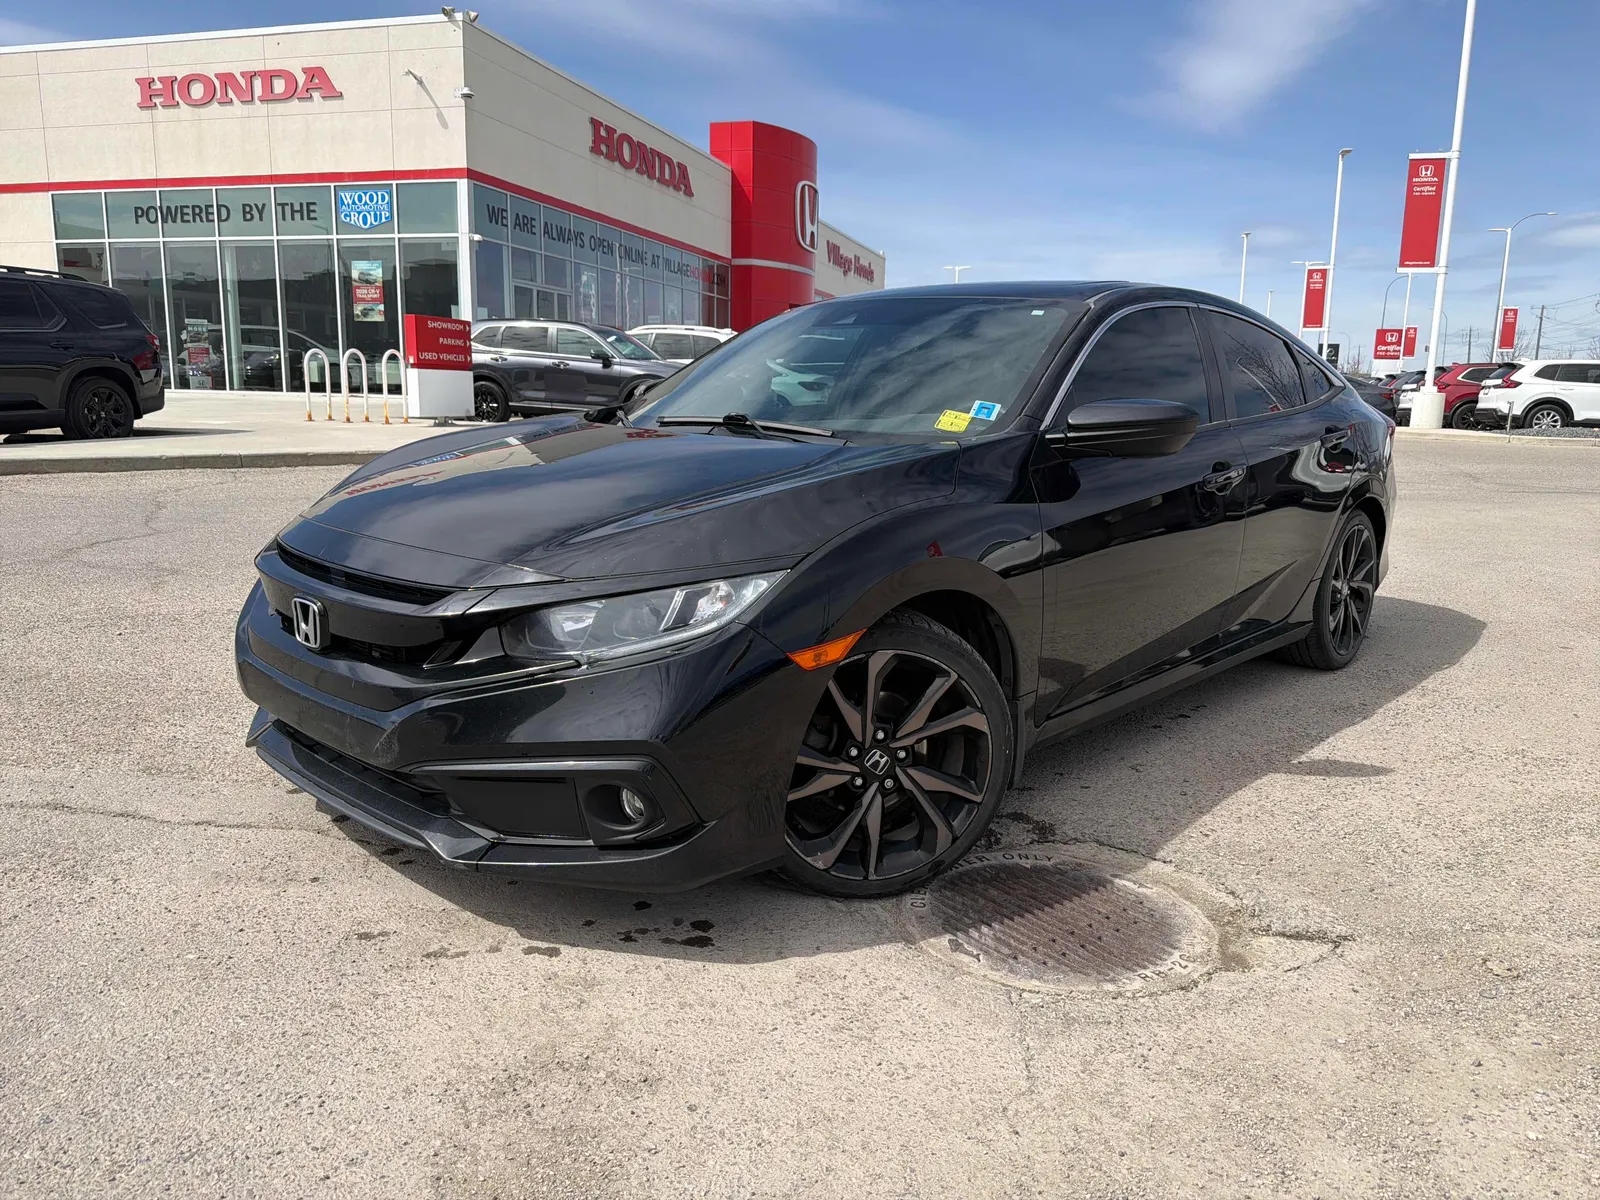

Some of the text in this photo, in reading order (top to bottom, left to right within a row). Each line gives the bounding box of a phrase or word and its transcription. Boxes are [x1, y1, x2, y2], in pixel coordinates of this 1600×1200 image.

[135, 66, 342, 107] HONDA
[588, 116, 694, 198] HONDA
[340, 191, 389, 205] WOOD
[134, 202, 318, 225] POWERED BY THE
[341, 211, 389, 228] GROUP
[486, 204, 508, 228] WE
[513, 212, 537, 235] ARE
[543, 221, 585, 249] ALWAYS
[589, 235, 614, 257] OPEN
[618, 243, 648, 266] ONLINE
[650, 253, 661, 270] AT
[826, 239, 875, 283] Village Honda
[427, 320, 464, 331] SHOWROOM
[439, 337, 465, 347] PARKING
[1376, 344, 1402, 352] Certifie
[418, 351, 465, 362] USED VEHICLES
[1002, 852, 1054, 863] ONLY
